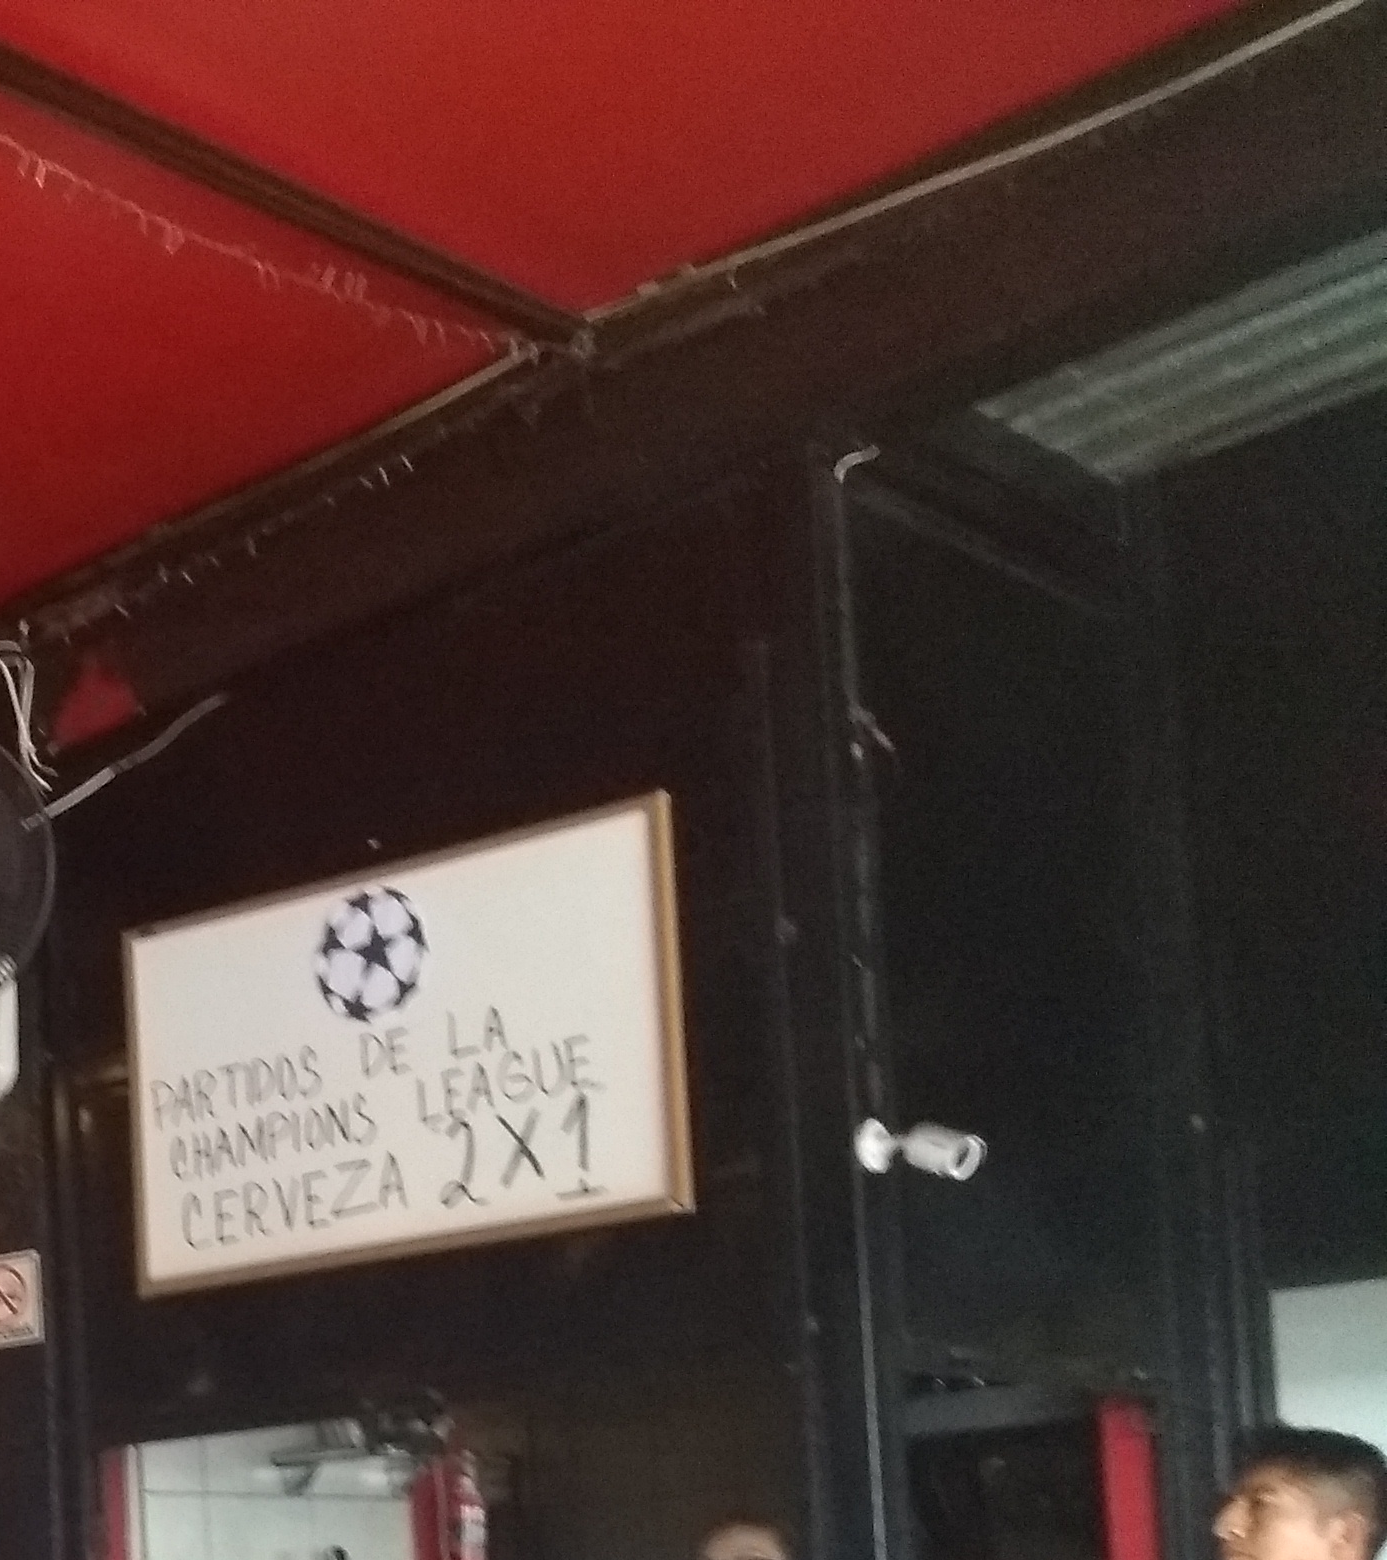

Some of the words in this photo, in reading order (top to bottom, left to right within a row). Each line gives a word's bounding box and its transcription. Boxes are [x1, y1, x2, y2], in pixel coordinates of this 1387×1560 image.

[150, 1045, 323, 1131] PARTIDOS
[359, 1026, 412, 1079] DE
[446, 1004, 508, 1060] LA
[169, 1092, 377, 1181] CHAMPIONS
[415, 1033, 607, 1130] LEAGUE
[180, 1150, 408, 1250] CERVEZA
